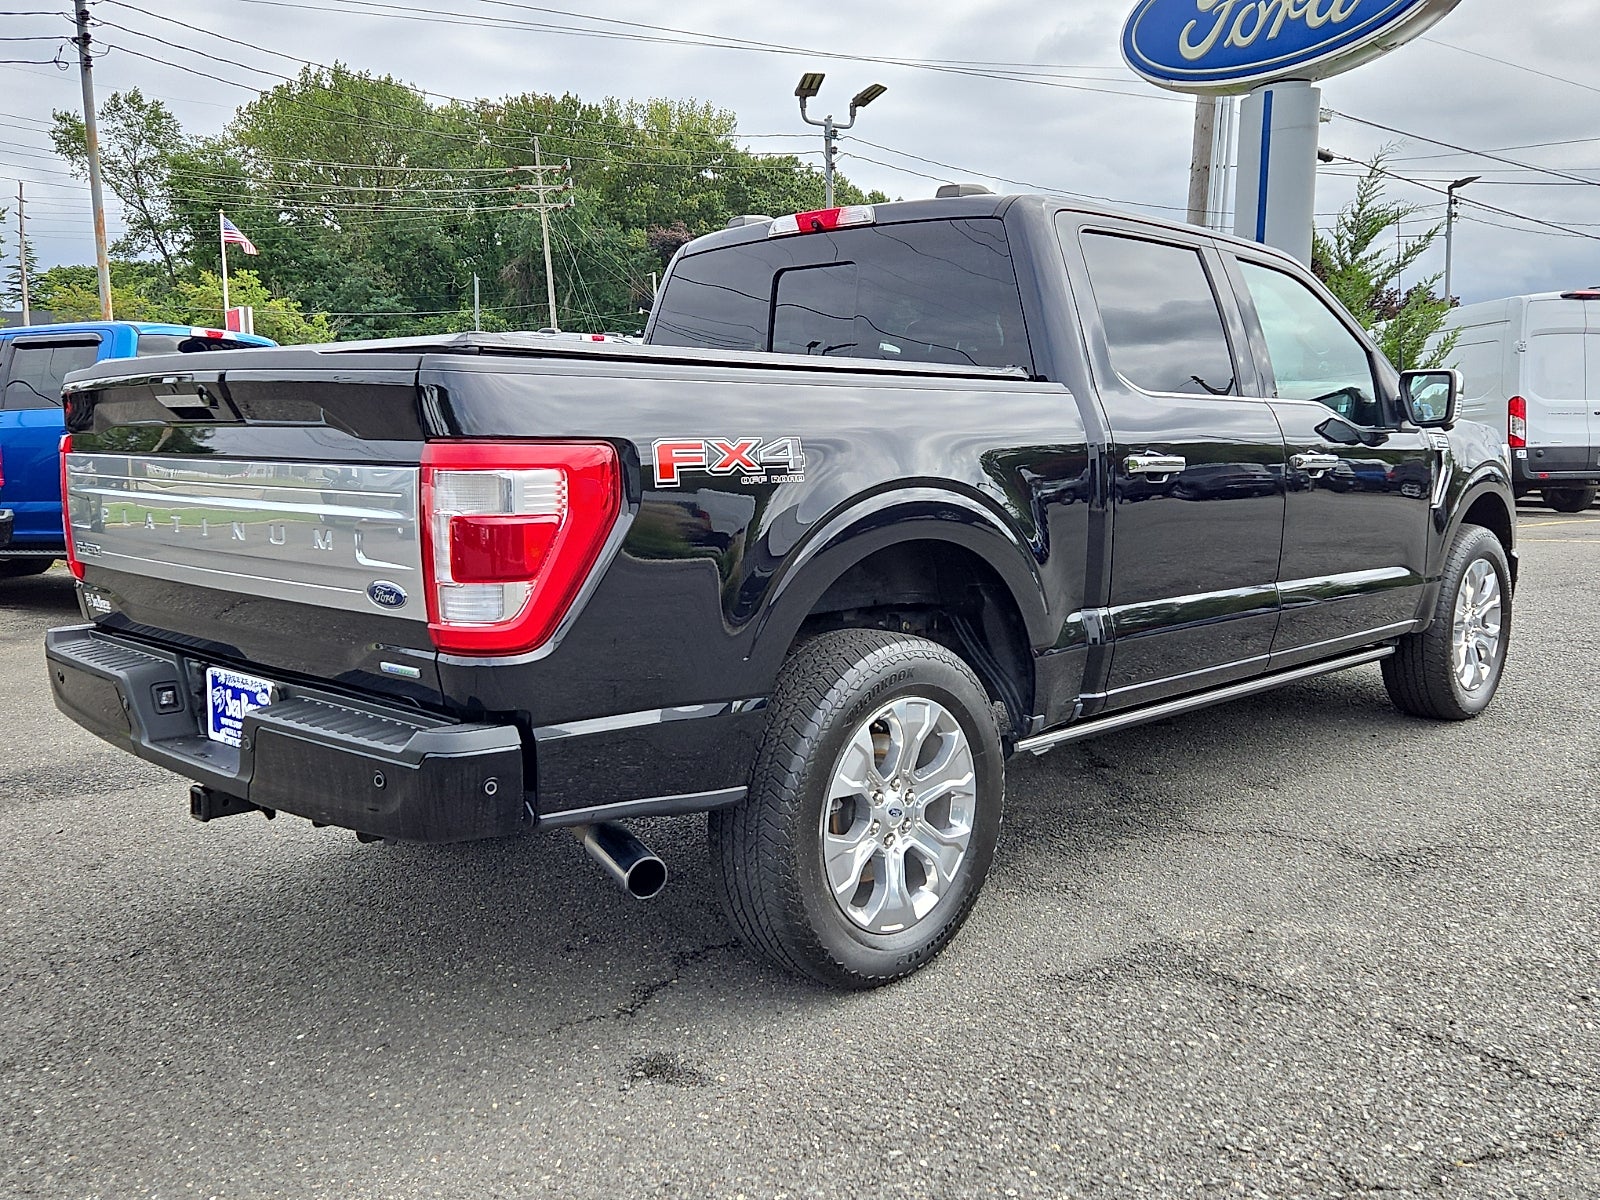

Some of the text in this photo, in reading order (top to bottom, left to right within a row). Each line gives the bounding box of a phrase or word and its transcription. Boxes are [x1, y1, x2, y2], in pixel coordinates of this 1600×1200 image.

[651, 437, 805, 488] FX4
[740, 474, 805, 485] OFF ROAD
[99, 507, 333, 551] PLATINUM
